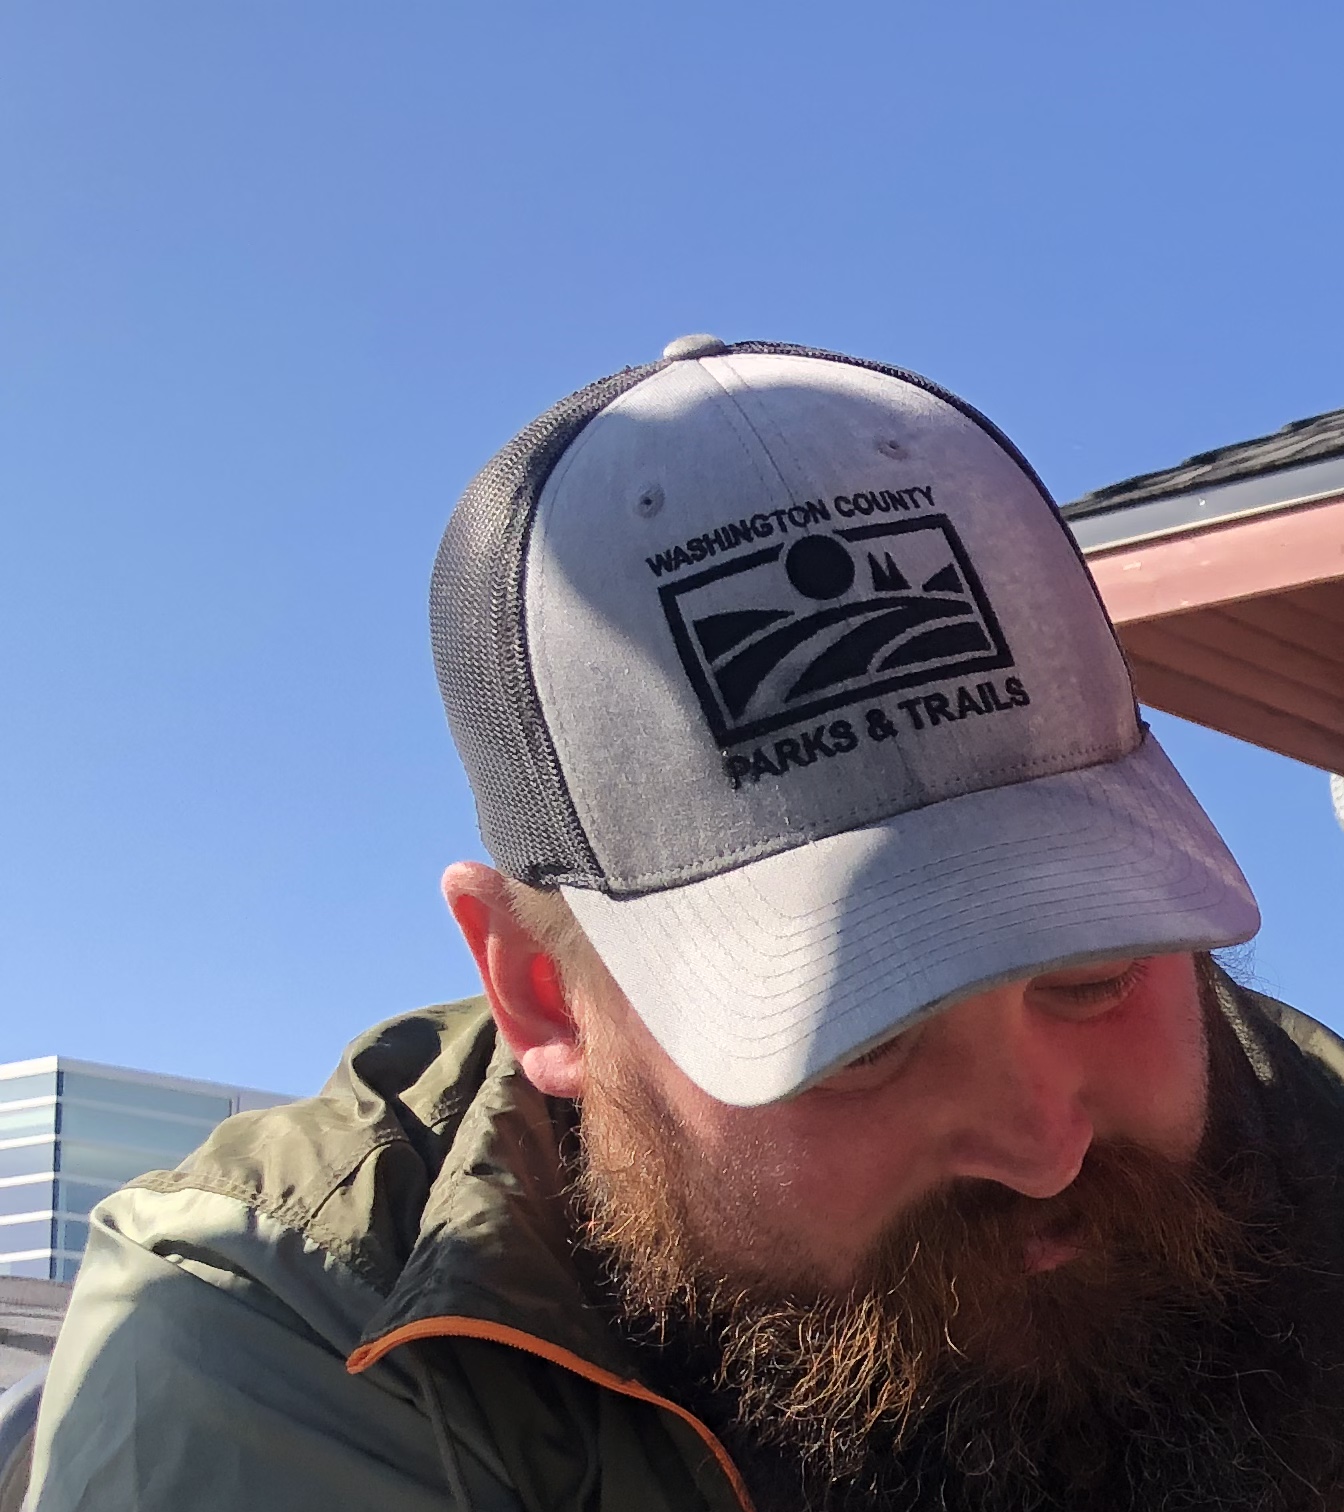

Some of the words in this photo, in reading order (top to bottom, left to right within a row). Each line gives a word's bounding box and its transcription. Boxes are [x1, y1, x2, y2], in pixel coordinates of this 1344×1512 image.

[646, 499, 830, 577] WASHINGTON
[834, 486, 936, 518] COUNTY
[725, 722, 859, 788] PARKS
[868, 709, 898, 742] &
[898, 676, 1030, 730] TRAILS
